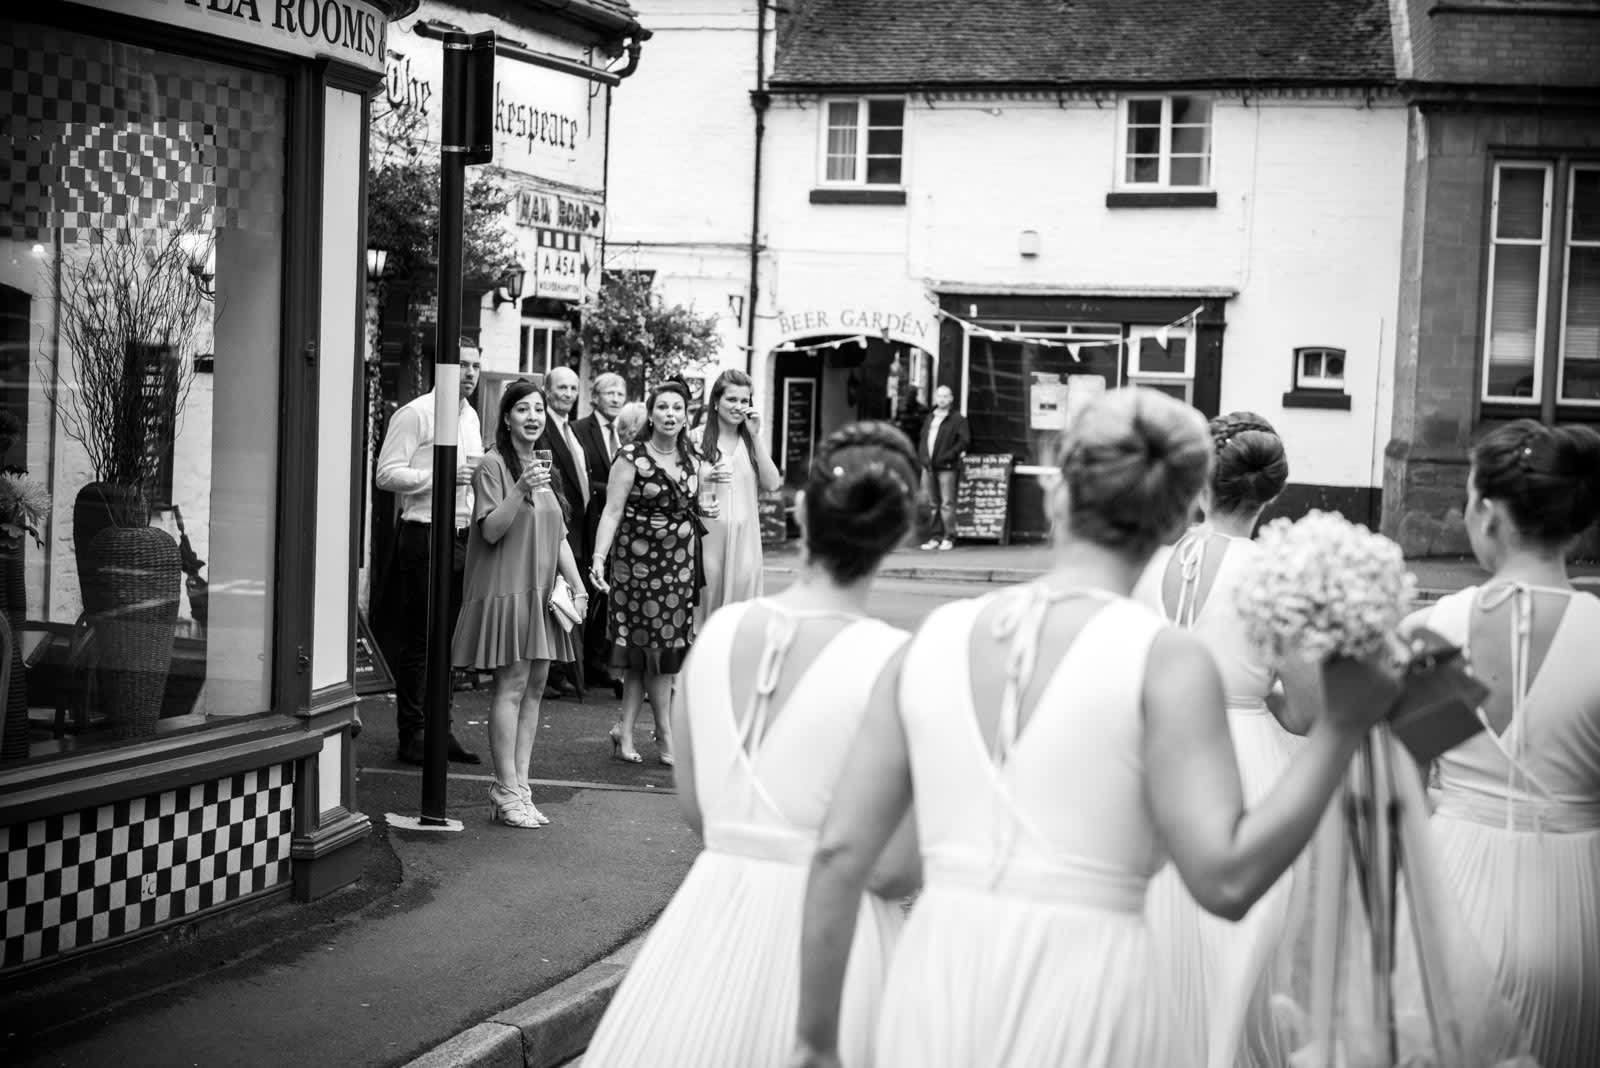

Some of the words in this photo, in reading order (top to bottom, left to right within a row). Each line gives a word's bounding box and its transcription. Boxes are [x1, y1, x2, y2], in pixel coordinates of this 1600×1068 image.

[271, 0, 375, 57] ROOMS
[386, 49, 432, 117] The
[494, 80, 578, 155] kespeare
[557, 199, 590, 231] ROAD
[543, 254, 551, 275] A
[555, 255, 576, 277] 454
[778, 311, 829, 334] BEER
